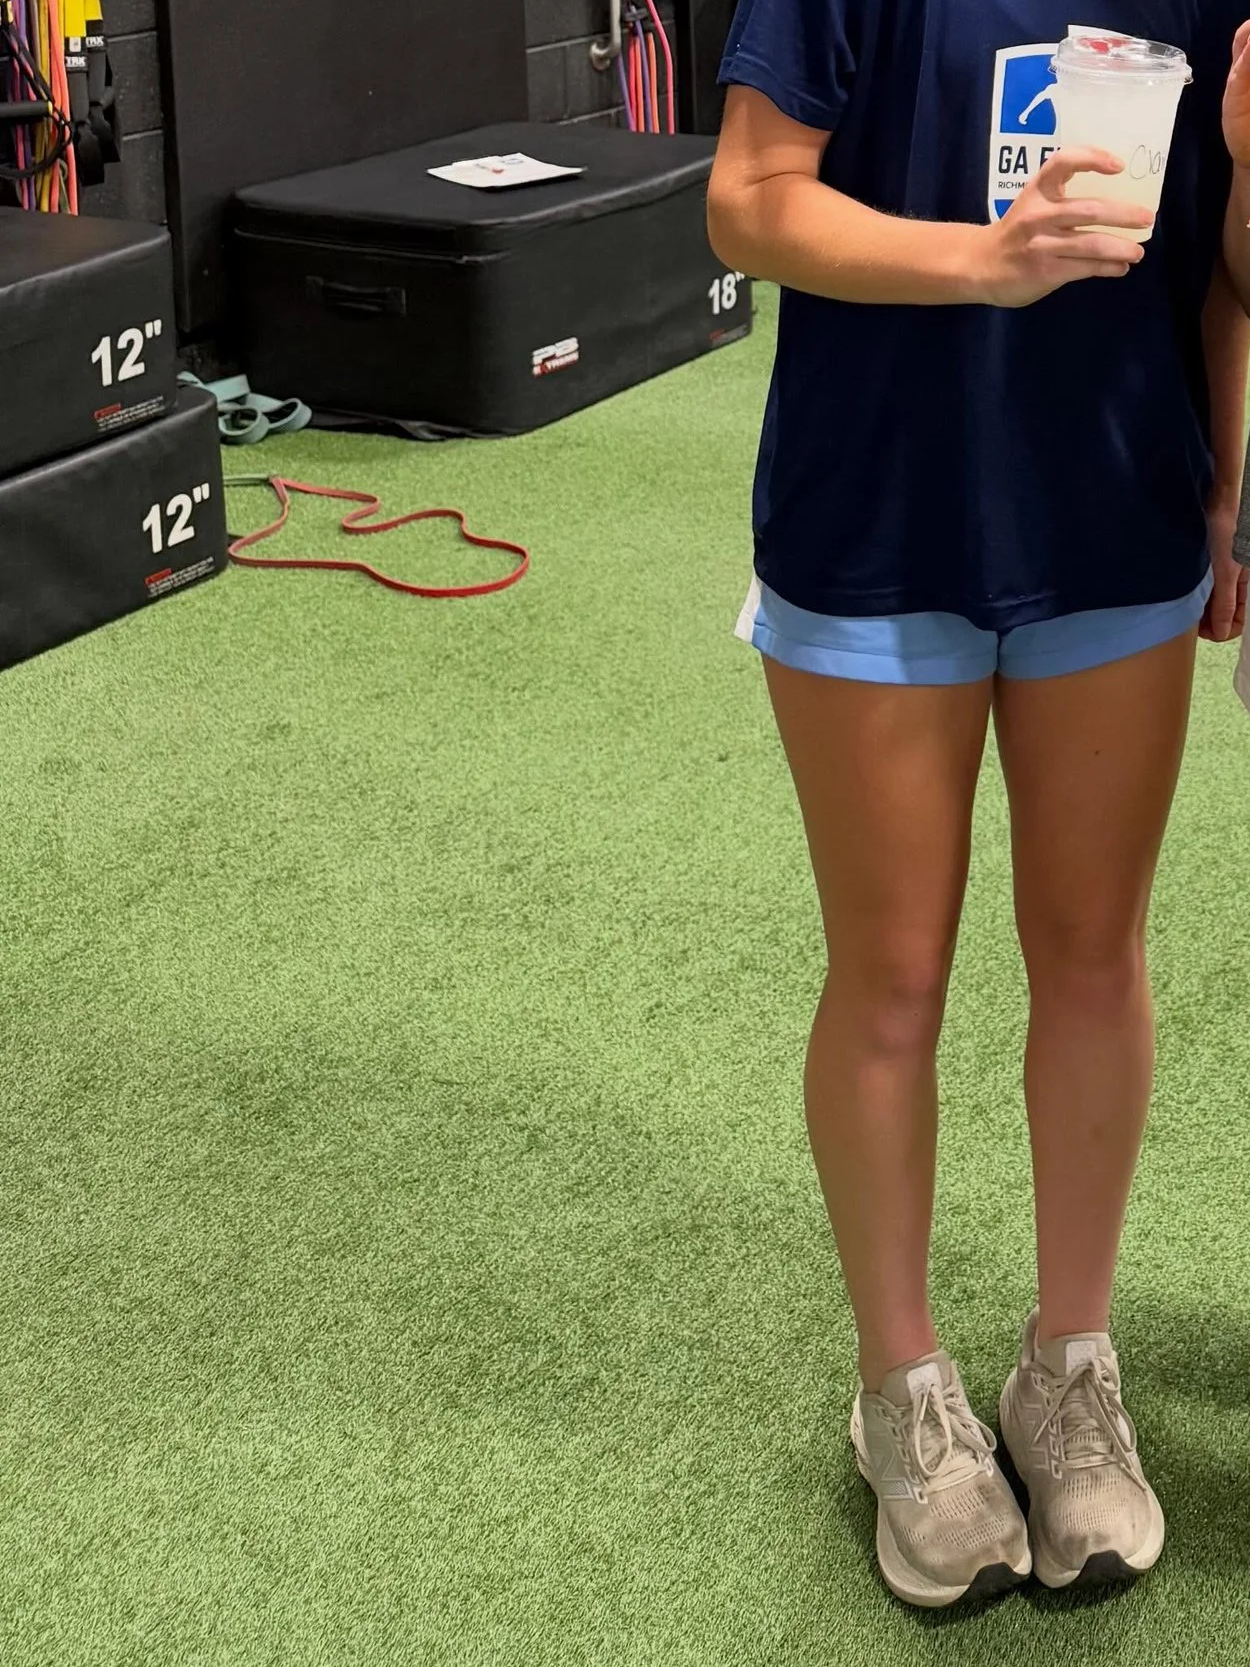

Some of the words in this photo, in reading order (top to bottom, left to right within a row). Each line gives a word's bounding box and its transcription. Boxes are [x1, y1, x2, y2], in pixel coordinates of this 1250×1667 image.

[998, 145, 1029, 174] GA
[998, 181, 1028, 189] RICHM
[91, 319, 162, 387] 12"
[142, 482, 210, 554] 12"
